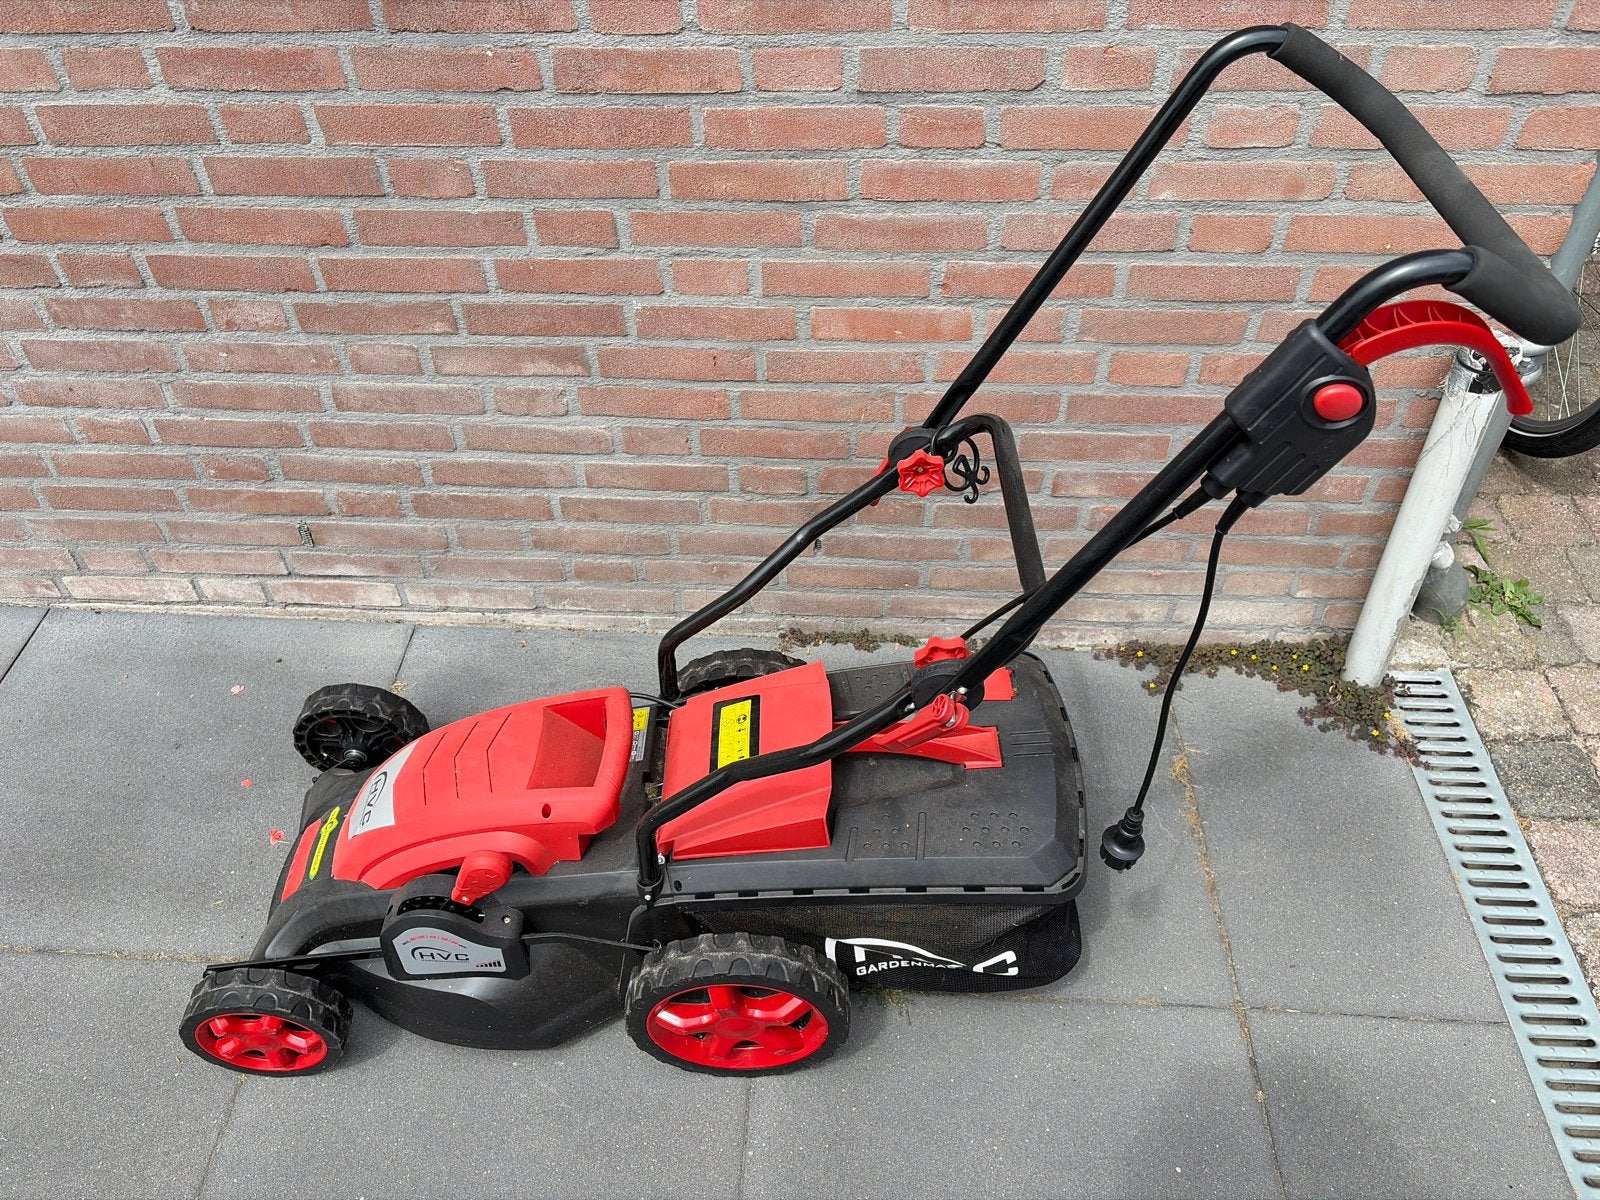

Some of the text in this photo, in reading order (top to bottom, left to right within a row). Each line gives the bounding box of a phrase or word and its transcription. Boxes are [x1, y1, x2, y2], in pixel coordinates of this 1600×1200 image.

[361, 778, 382, 827] HVC
[419, 951, 470, 961] HVC
[855, 960, 948, 976] GARDENMA
